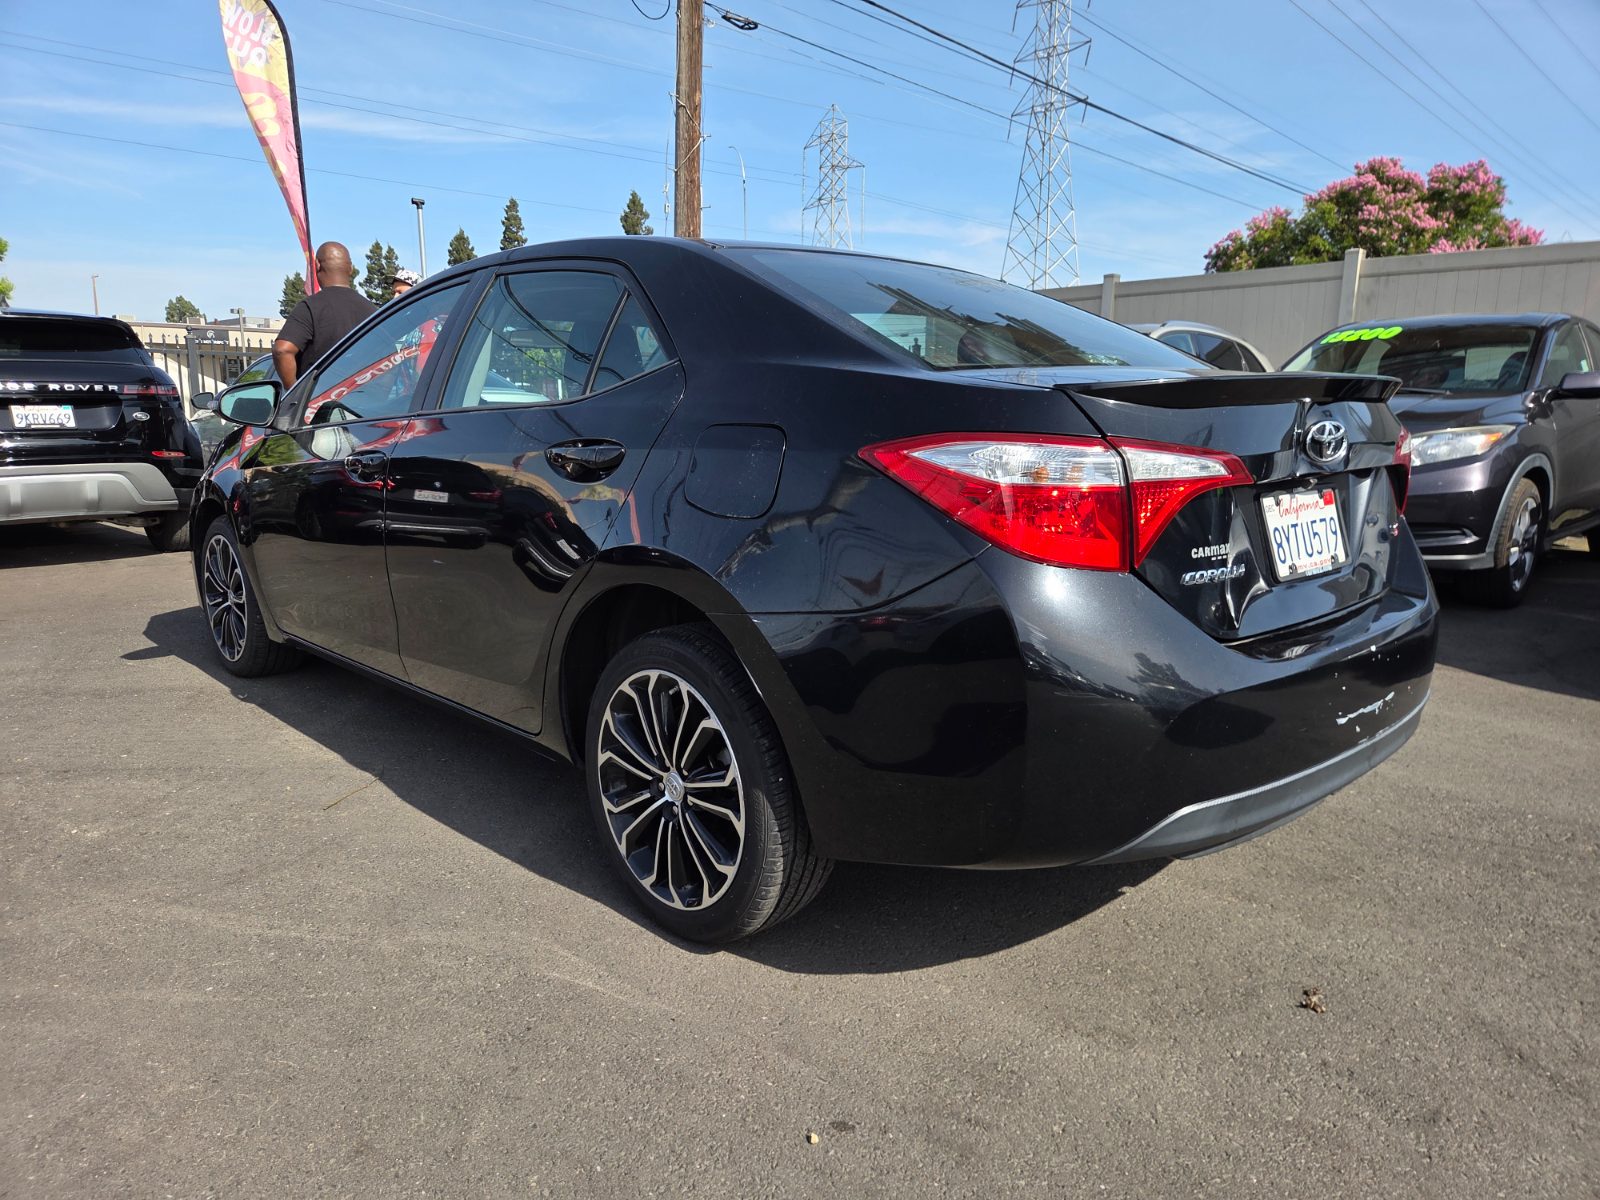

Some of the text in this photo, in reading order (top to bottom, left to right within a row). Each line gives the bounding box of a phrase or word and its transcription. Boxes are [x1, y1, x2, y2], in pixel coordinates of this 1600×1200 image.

[48, 383, 119, 392] ROVER
[15, 412, 72, 426] 9KRV669
[1273, 516, 1338, 564] 8YTU579
